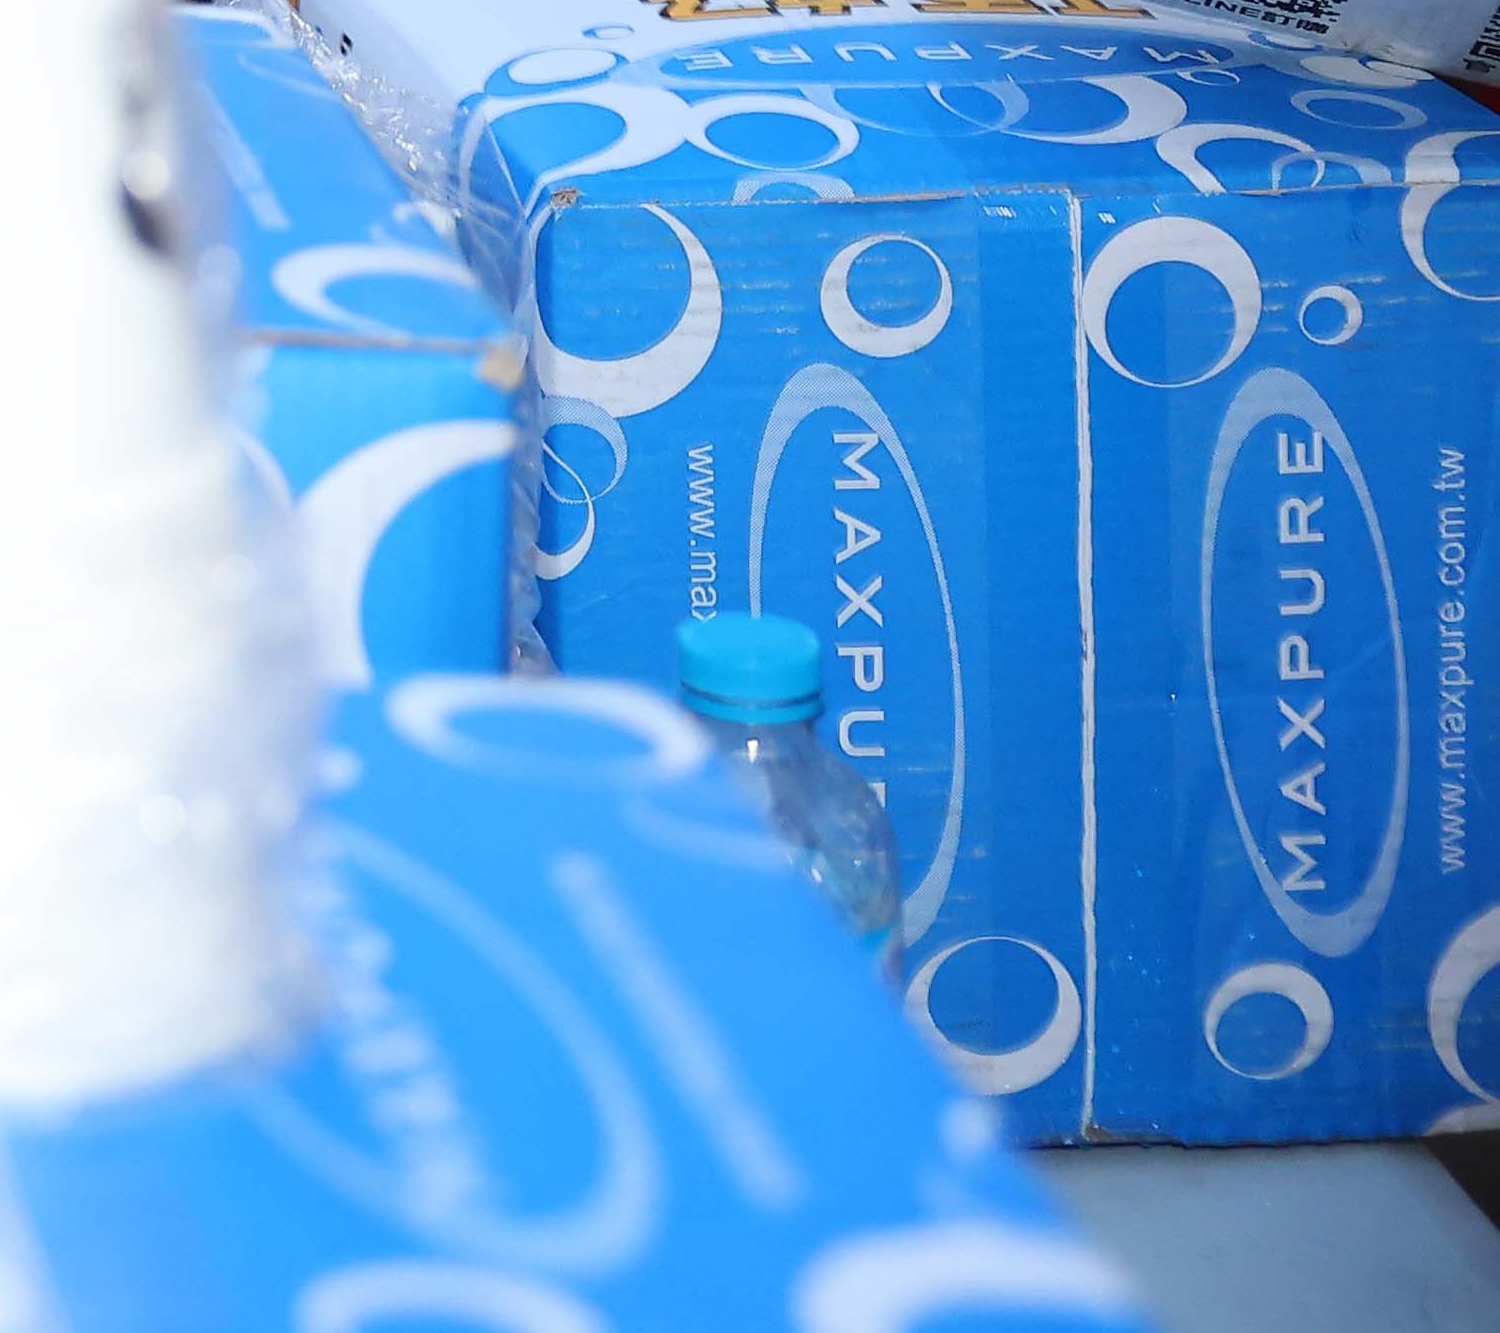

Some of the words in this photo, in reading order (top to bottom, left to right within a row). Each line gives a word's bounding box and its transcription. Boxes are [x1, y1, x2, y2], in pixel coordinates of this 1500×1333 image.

[675, 41, 1221, 71] MAXPURE
[832, 430, 887, 809] MAXPU
[1278, 429, 1326, 893] MAXPURE
[1433, 447, 1474, 876] www.maxpure.com.tw
